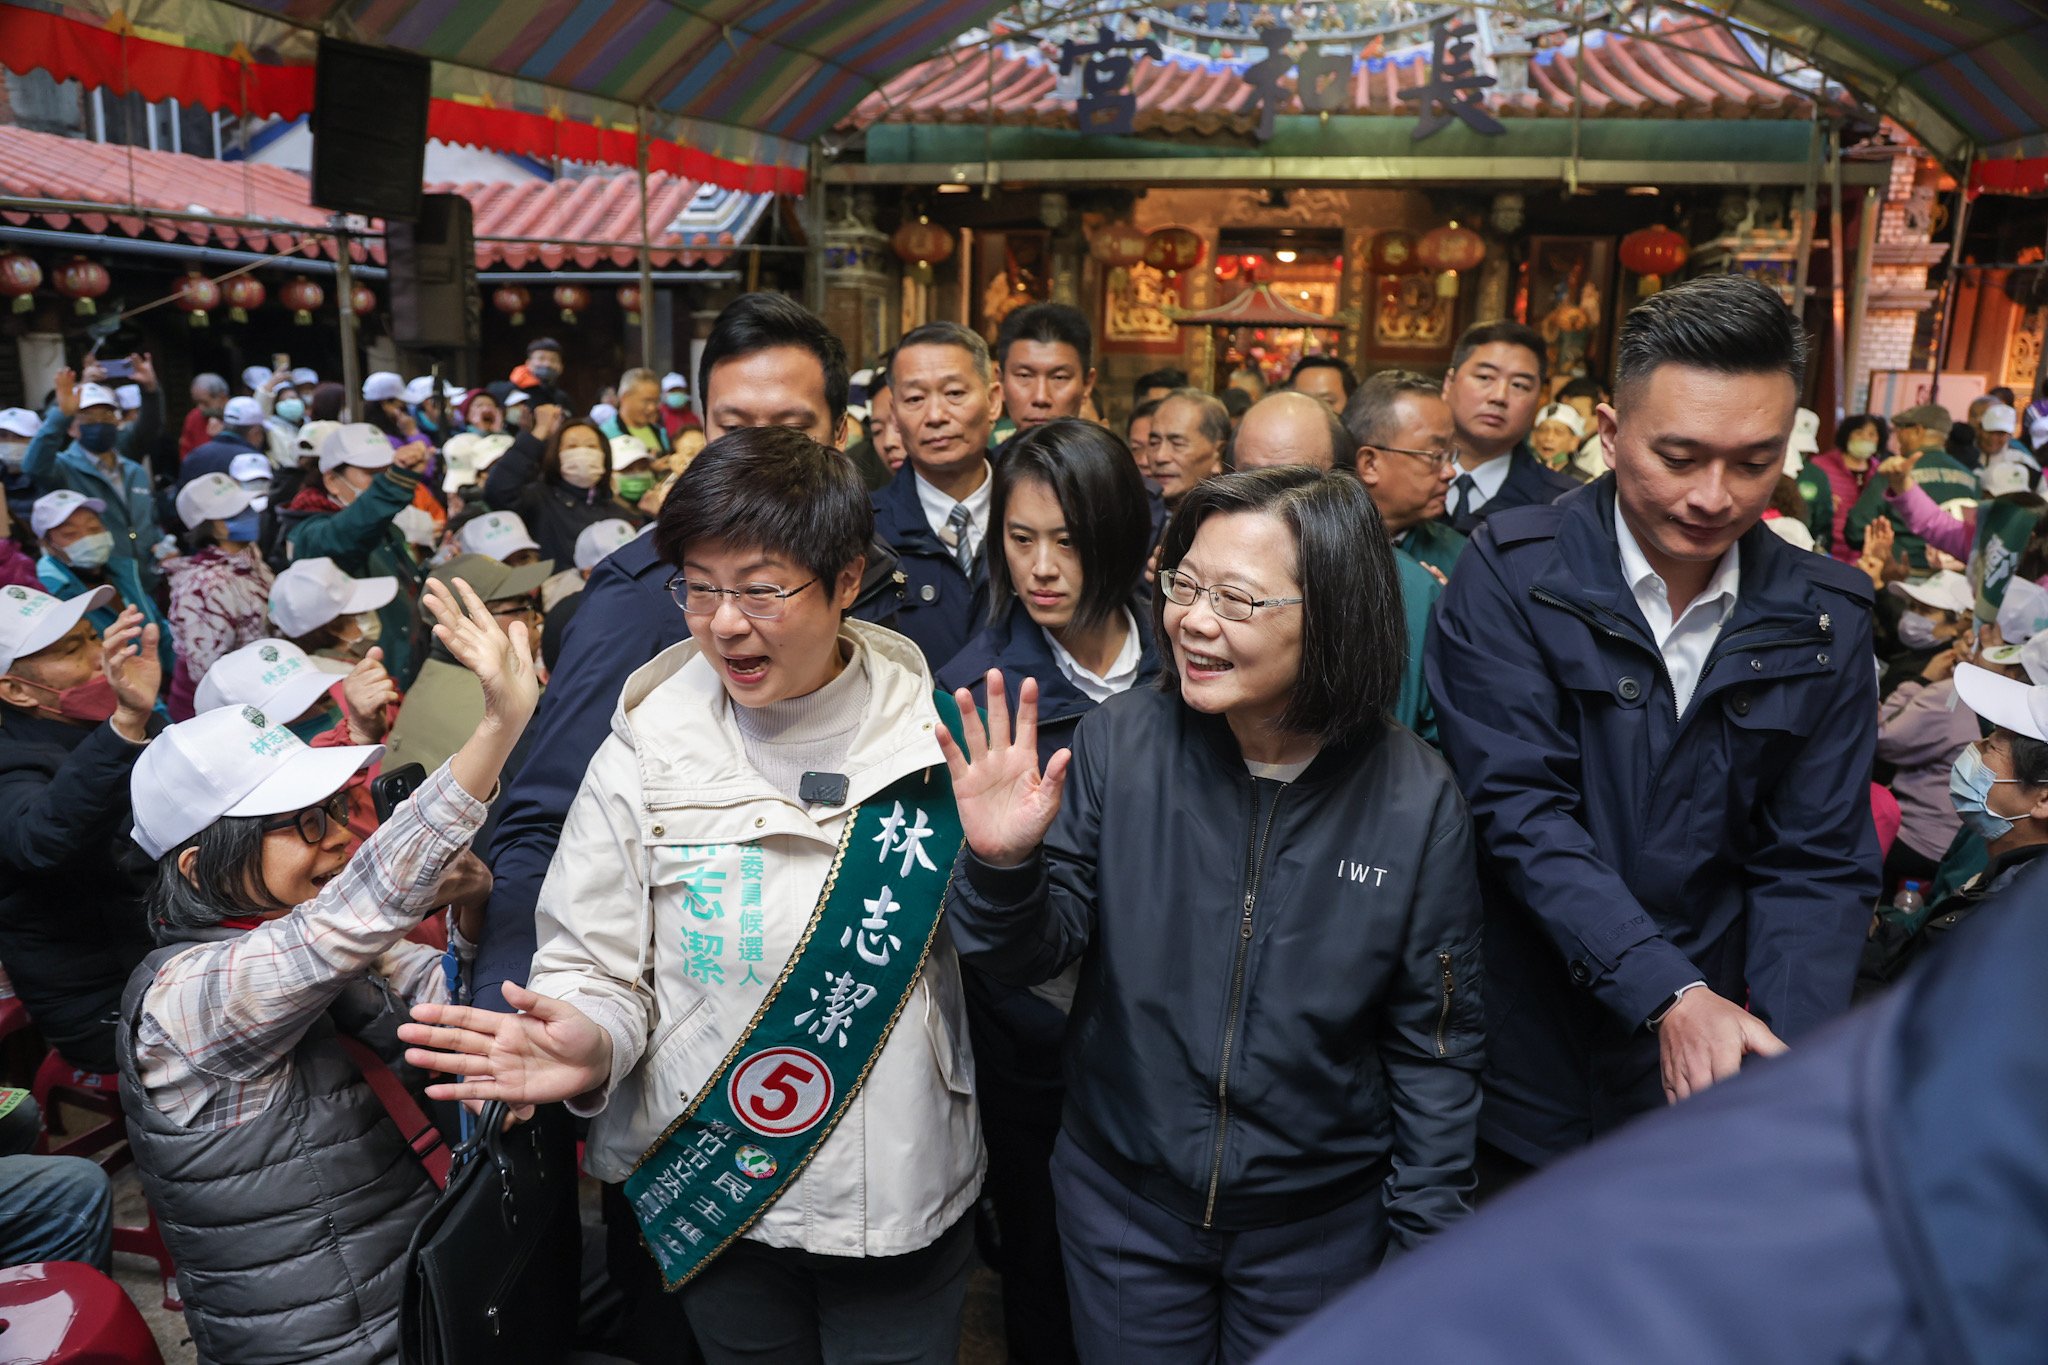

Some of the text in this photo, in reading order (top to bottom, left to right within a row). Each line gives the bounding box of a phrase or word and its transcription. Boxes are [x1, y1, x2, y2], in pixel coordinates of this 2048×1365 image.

[1337, 859, 1388, 887] IWT
[794, 800, 937, 1048] 林志潔
[750, 1062, 814, 1121] 5
